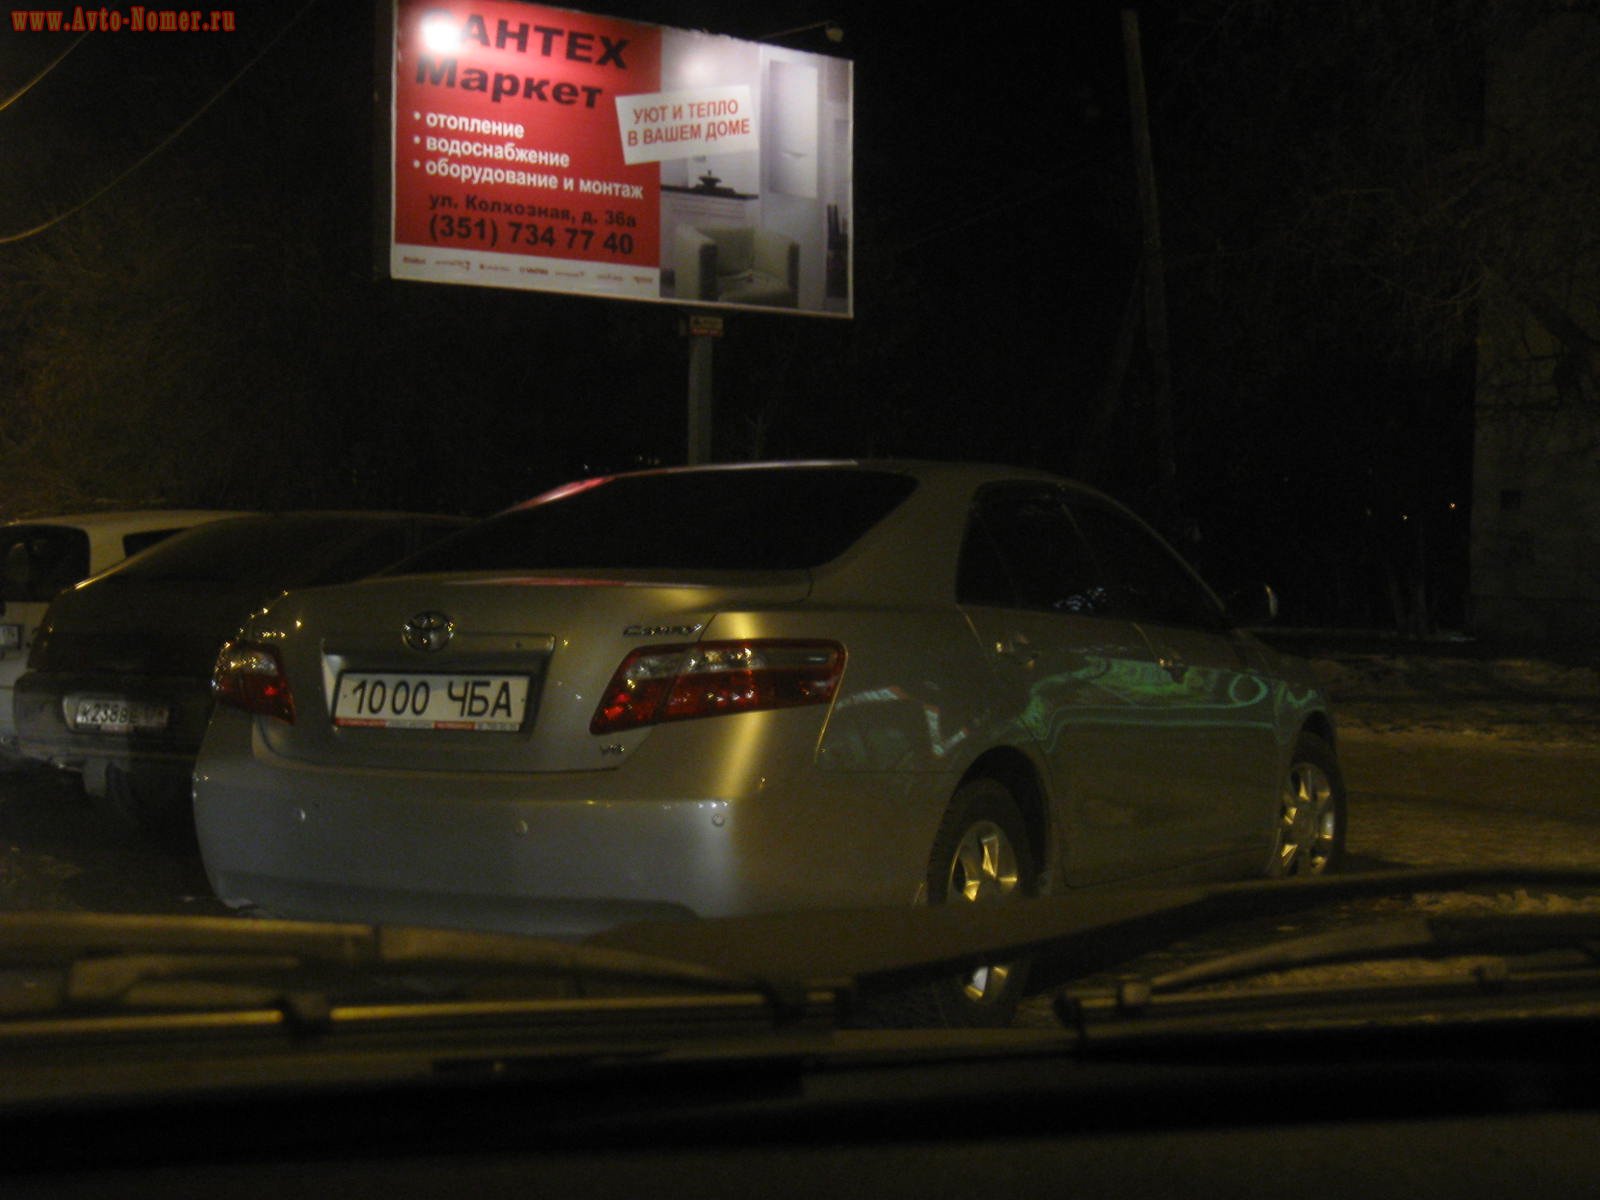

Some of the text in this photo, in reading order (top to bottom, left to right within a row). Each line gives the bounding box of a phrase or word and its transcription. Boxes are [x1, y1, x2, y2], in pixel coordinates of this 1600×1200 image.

[430, 13, 630, 69] АНТЕХ
[415, 53, 603, 109] Маркет
[426, 112, 525, 139] отопление
[633, 98, 738, 124] УЮТ И ТЕПЛО
[627, 118, 750, 147] В ВАШЕМ ДОМЕ
[426, 136, 570, 168] водоснабжение
[426, 158, 643, 199] оборудование и монтаж
[429, 193, 636, 228] ул. Колхозная, д. 36а
[429, 213, 634, 255] (351) 734 77 40
[447, 681, 512, 717] ЧБА
